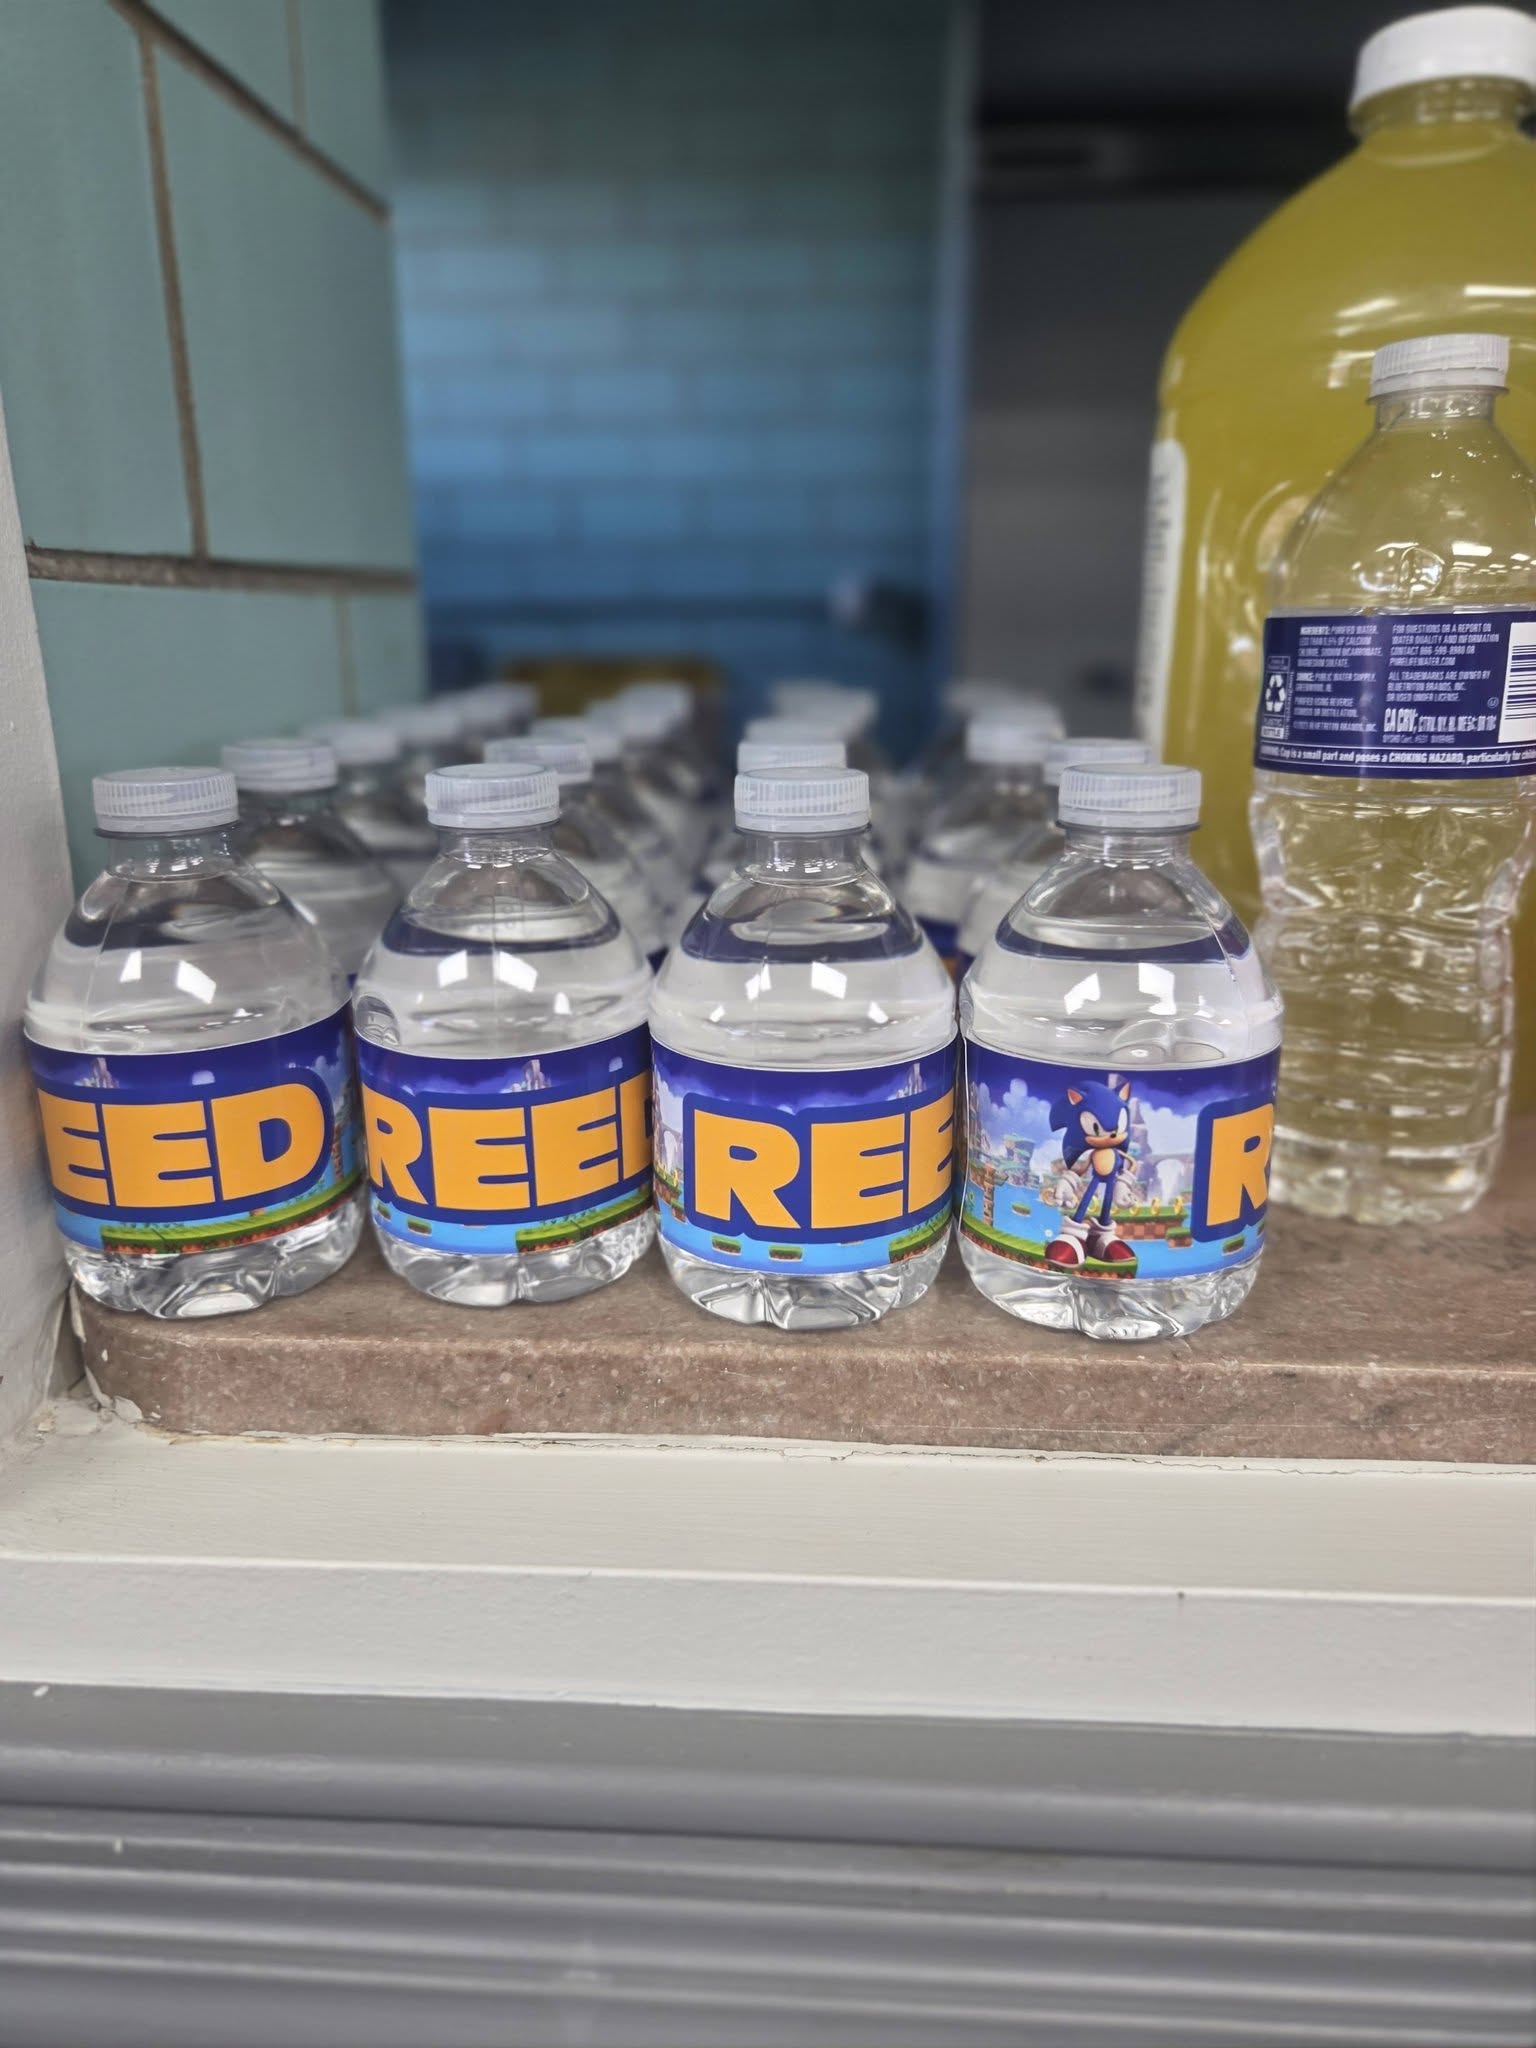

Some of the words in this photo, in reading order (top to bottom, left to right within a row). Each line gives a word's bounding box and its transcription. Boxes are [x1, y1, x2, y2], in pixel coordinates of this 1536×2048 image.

[1392, 624, 1405, 634] FOR
[1405, 624, 1441, 634] QUESTIONS
[1441, 624, 1451, 633] OR
[1451, 624, 1457, 633] A
[1457, 623, 1482, 633] REPORT
[1392, 635, 1414, 645] WATER
[1414, 634, 1442, 645] QUALITY
[1442, 634, 1457, 644] AND
[1457, 634, 1500, 644] INFORMATION
[1390, 646, 1419, 656] CONTACT
[1466, 645, 1475, 654] OR
[1389, 656, 1456, 667] PURELIFEWATER.COM
[1333, 672, 1353, 682] WATER
[1388, 671, 1400, 681] ALL
[1401, 671, 1444, 681] TRADEMARKS
[1445, 671, 1458, 680] ARE
[1458, 670, 1482, 680] OWNED
[1482, 670, 1492, 680] BY
[1329, 697, 1354, 707] REVERSE
[1386, 693, 1396, 702] OR
[1396, 693, 1413, 702] USED
[1413, 693, 1434, 702] UNDER
[1384, 707, 1397, 732] CA
[1290, 747, 1297, 758] is
[1302, 749, 1322, 760] small
[1322, 749, 1338, 762] part
[1338, 750, 1355, 761] and
[1355, 752, 1380, 764] poses
[1381, 753, 1388, 763] a
[1389, 751, 1427, 763] CHOKING
[1428, 751, 1466, 765] HAZARD,
[1466, 751, 1511, 765] particularly
[1511, 749, 1521, 761] for
[1206, 1102, 1275, 1228] R
